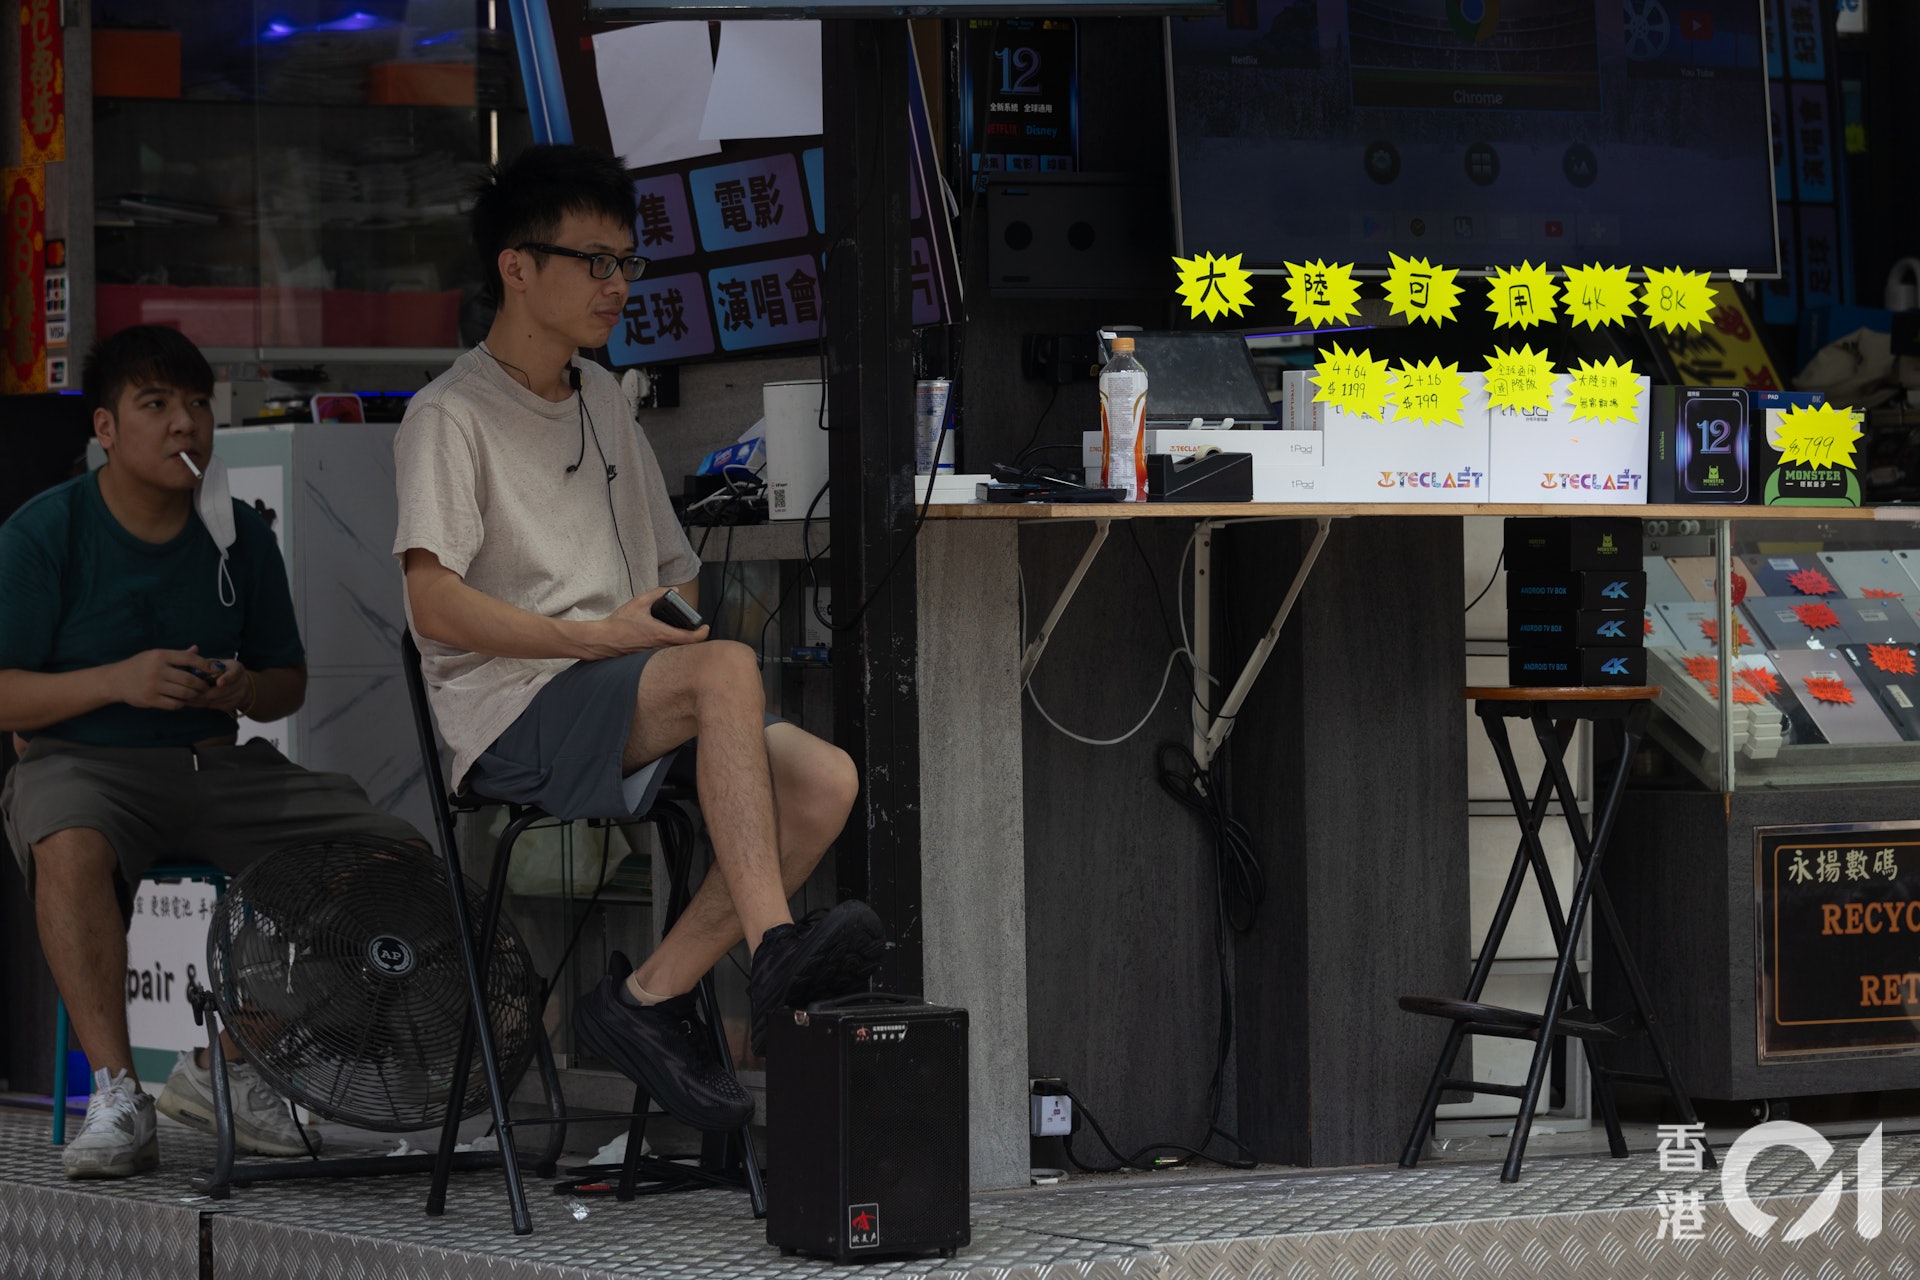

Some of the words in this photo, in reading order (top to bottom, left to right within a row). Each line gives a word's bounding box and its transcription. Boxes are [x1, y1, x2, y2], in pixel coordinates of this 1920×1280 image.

[1231, 56, 1258, 65] Netflix
[993, 47, 1042, 96] 12
[1453, 89, 1503, 105] Chrome
[1025, 124, 1058, 138] Disney
[631, 193, 673, 248] 集
[714, 173, 784, 232] 電影
[1196, 261, 1230, 304] 大
[1304, 270, 1331, 306] 陸
[1410, 273, 1433, 309] 可
[1509, 284, 1534, 318] 用
[1581, 284, 1606, 312] 4K
[1660, 285, 1687, 312] 8K
[622, 288, 689, 346] 足球
[717, 268, 818, 332] 演唱會
[49, 327, 64, 339] VISA
[1578, 374, 1618, 388] 大陸可用
[1696, 419, 1732, 455] 12
[1789, 436, 1835, 459] $799
[1396, 468, 1483, 489] TECLAST
[1559, 471, 1642, 490] TECLAST
[1785, 470, 1842, 481] MONSTER
[1520, 586, 1546, 595] ANDROID
[1546, 586, 1554, 595] TV
[1554, 586, 1568, 595] BOX
[1601, 580, 1630, 599] 4K
[1519, 624, 1542, 633] ANDROID
[1542, 624, 1550, 633] TV
[1551, 624, 1563, 633] BOX
[1596, 620, 1627, 638] 4K
[1522, 663, 1547, 672] ANDROID
[1547, 663, 1555, 672] TV
[1555, 663, 1568, 672] BOX
[1600, 657, 1630, 675] 4K
[1788, 848, 1898, 885] 永揚數碼
[1820, 900, 1920, 936] RECYC
[1859, 973, 1920, 1008] RET
